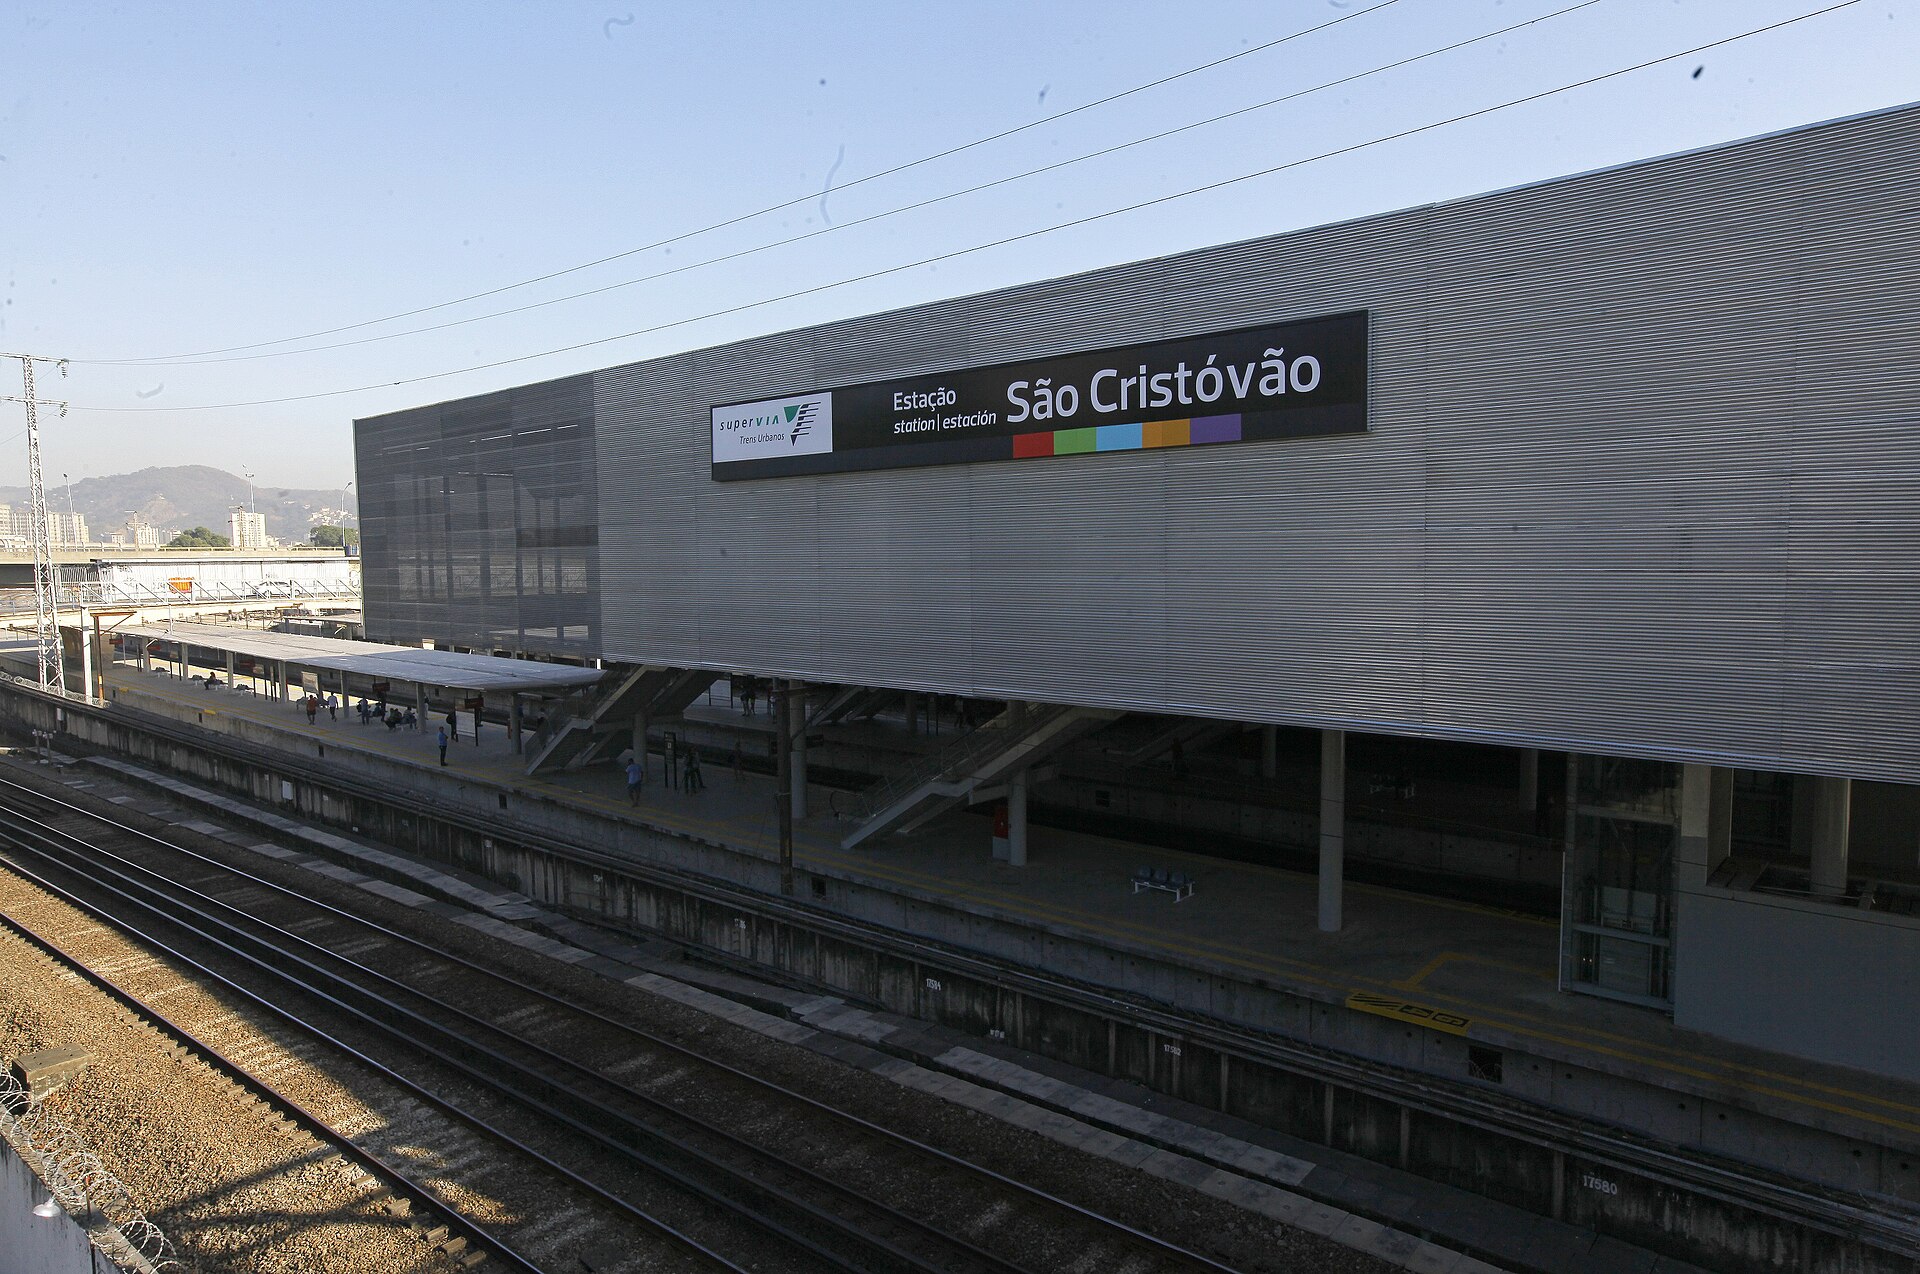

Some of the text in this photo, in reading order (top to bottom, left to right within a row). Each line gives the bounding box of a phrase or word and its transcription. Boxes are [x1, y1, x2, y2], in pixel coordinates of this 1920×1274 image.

[1006, 347, 1321, 423] São Cristóvão
[893, 386, 957, 412] Estação
[739, 432, 785, 445] Trens Urbanos
[1583, 1174, 1618, 1195] 17580
